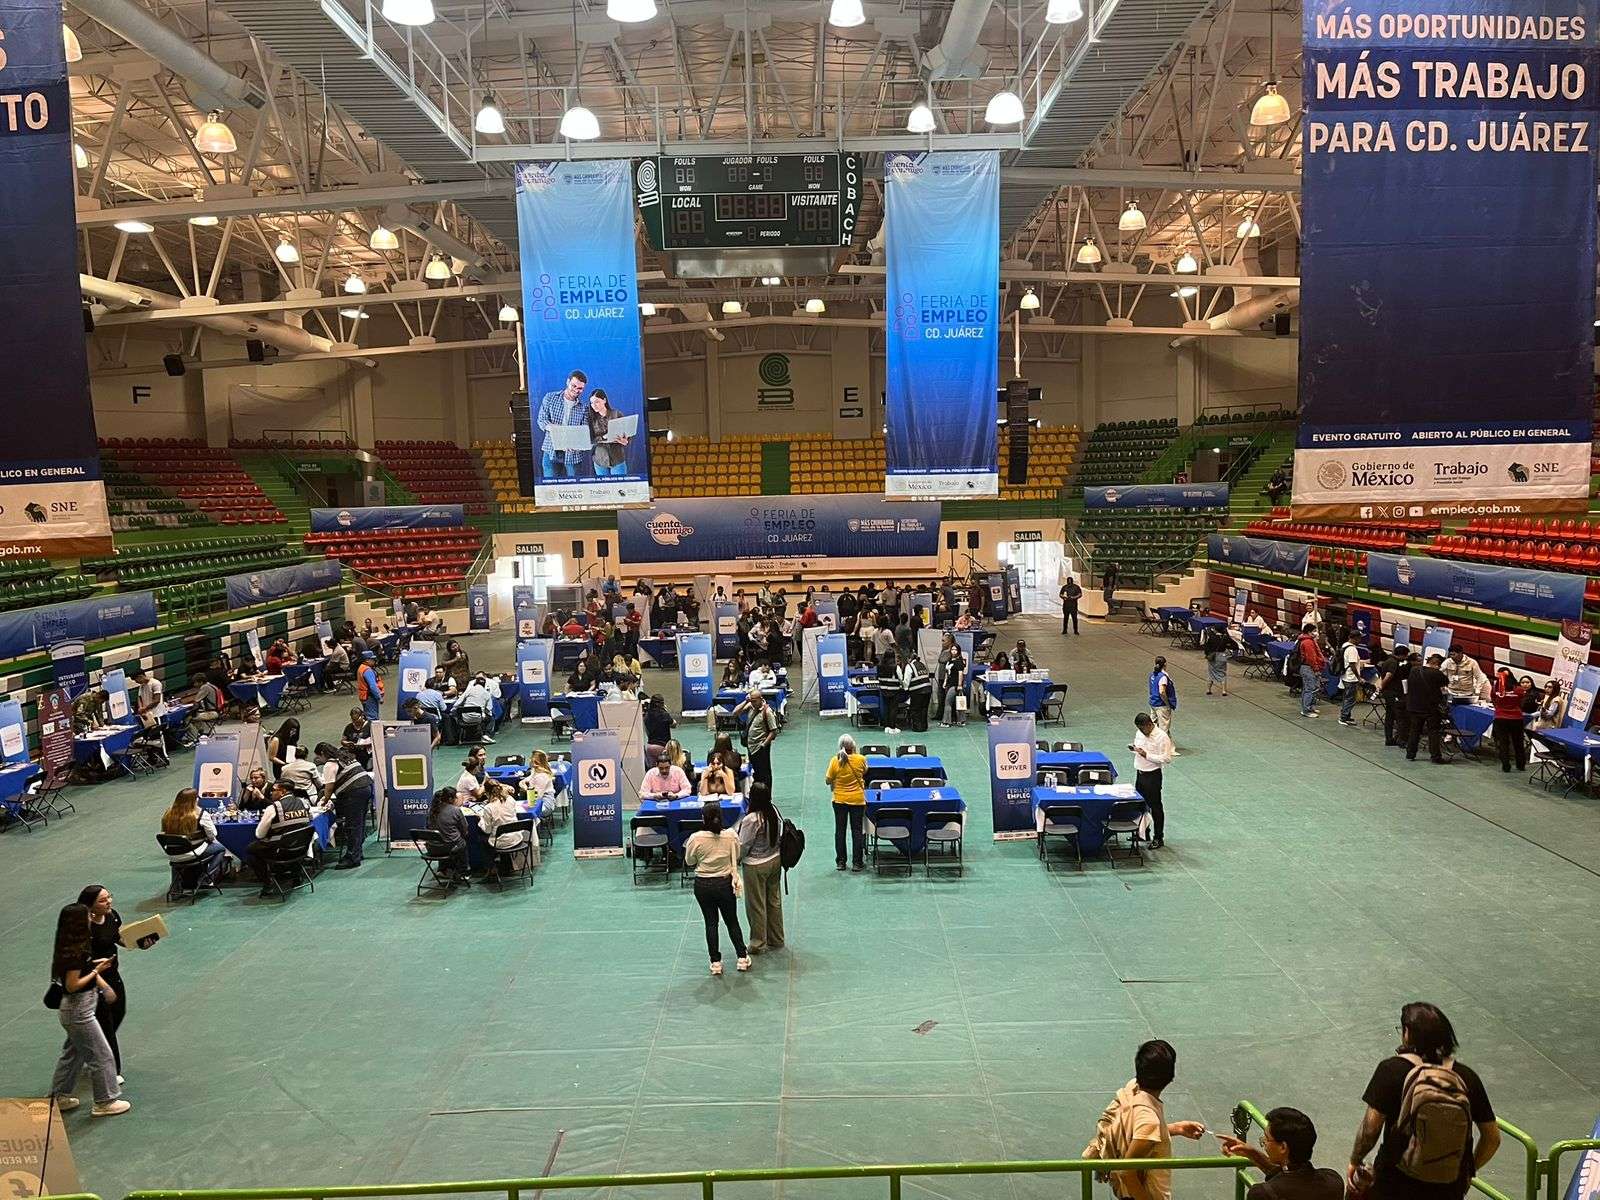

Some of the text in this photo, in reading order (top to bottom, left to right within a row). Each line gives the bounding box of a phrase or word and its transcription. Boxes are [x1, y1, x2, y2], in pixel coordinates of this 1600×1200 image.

[1316, 7, 1586, 40] MÁS OPORTUNIDADES
[1316, 50, 1585, 100] MÁS TRABAJO
[1309, 112, 1589, 153] PARA CD. JUÁREZ
[674, 158, 696, 166] FOULS
[722, 156, 778, 165] JUGADOR FOULS
[803, 155, 825, 164] FOULS
[671, 197, 702, 209] LOCAL
[791, 194, 838, 206] VISITANTE
[558, 274, 628, 289] FERIA DE
[560, 289, 628, 304] EMPLEO
[921, 294, 989, 308] FERIA DE
[584, 305, 625, 319] JUÁREZ
[921, 309, 988, 323] EMPLEO
[944, 325, 985, 339] JUÁREZ
[132, 386, 152, 404] F
[844, 387, 859, 403] E
[1312, 428, 1571, 442] EVENTO GRATUITO ABIERTO AL PÚBLICO EN GENERAL
[25, 469, 38, 477] EN
[40, 467, 86, 476] GENERAL
[1351, 461, 1415, 471] Gobierno de
[1434, 461, 1488, 478] Trabajo
[1533, 462, 1560, 473] SNE
[1351, 470, 1415, 487] México
[51, 501, 78, 512] SNE
[1430, 504, 1522, 516] empleo.gob.mx
[763, 508, 816, 519] FERIA DE
[646, 520, 682, 529] cuenta
[764, 519, 816, 531] EMPLEO
[653, 527, 693, 536] conmigo
[1015, 532, 1042, 541] SALIDA
[516, 544, 544, 554] SALIDA
[584, 781, 610, 790] opasa
